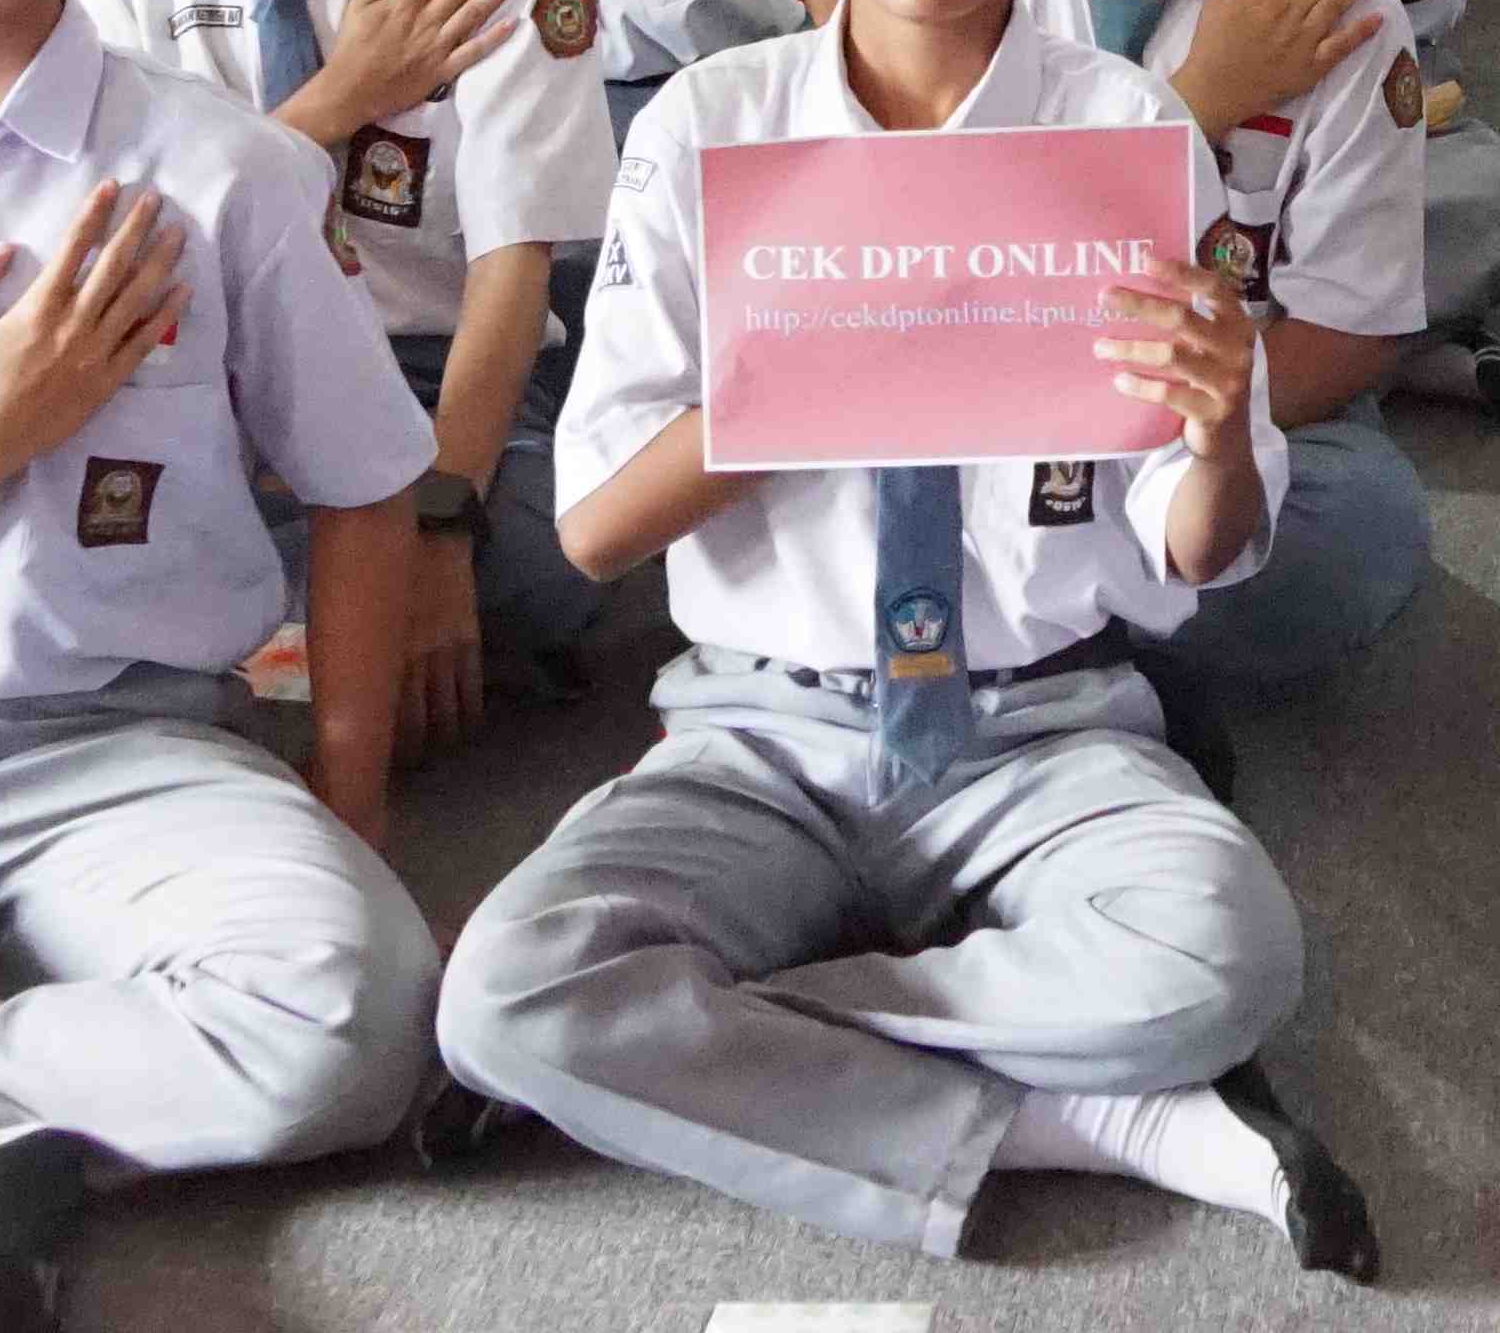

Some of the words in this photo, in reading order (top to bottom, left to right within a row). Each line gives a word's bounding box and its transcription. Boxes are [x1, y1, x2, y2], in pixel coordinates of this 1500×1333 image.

[744, 243, 847, 282] CEK
[860, 241, 959, 280] DPT
[966, 236, 1155, 278] ONLINE
